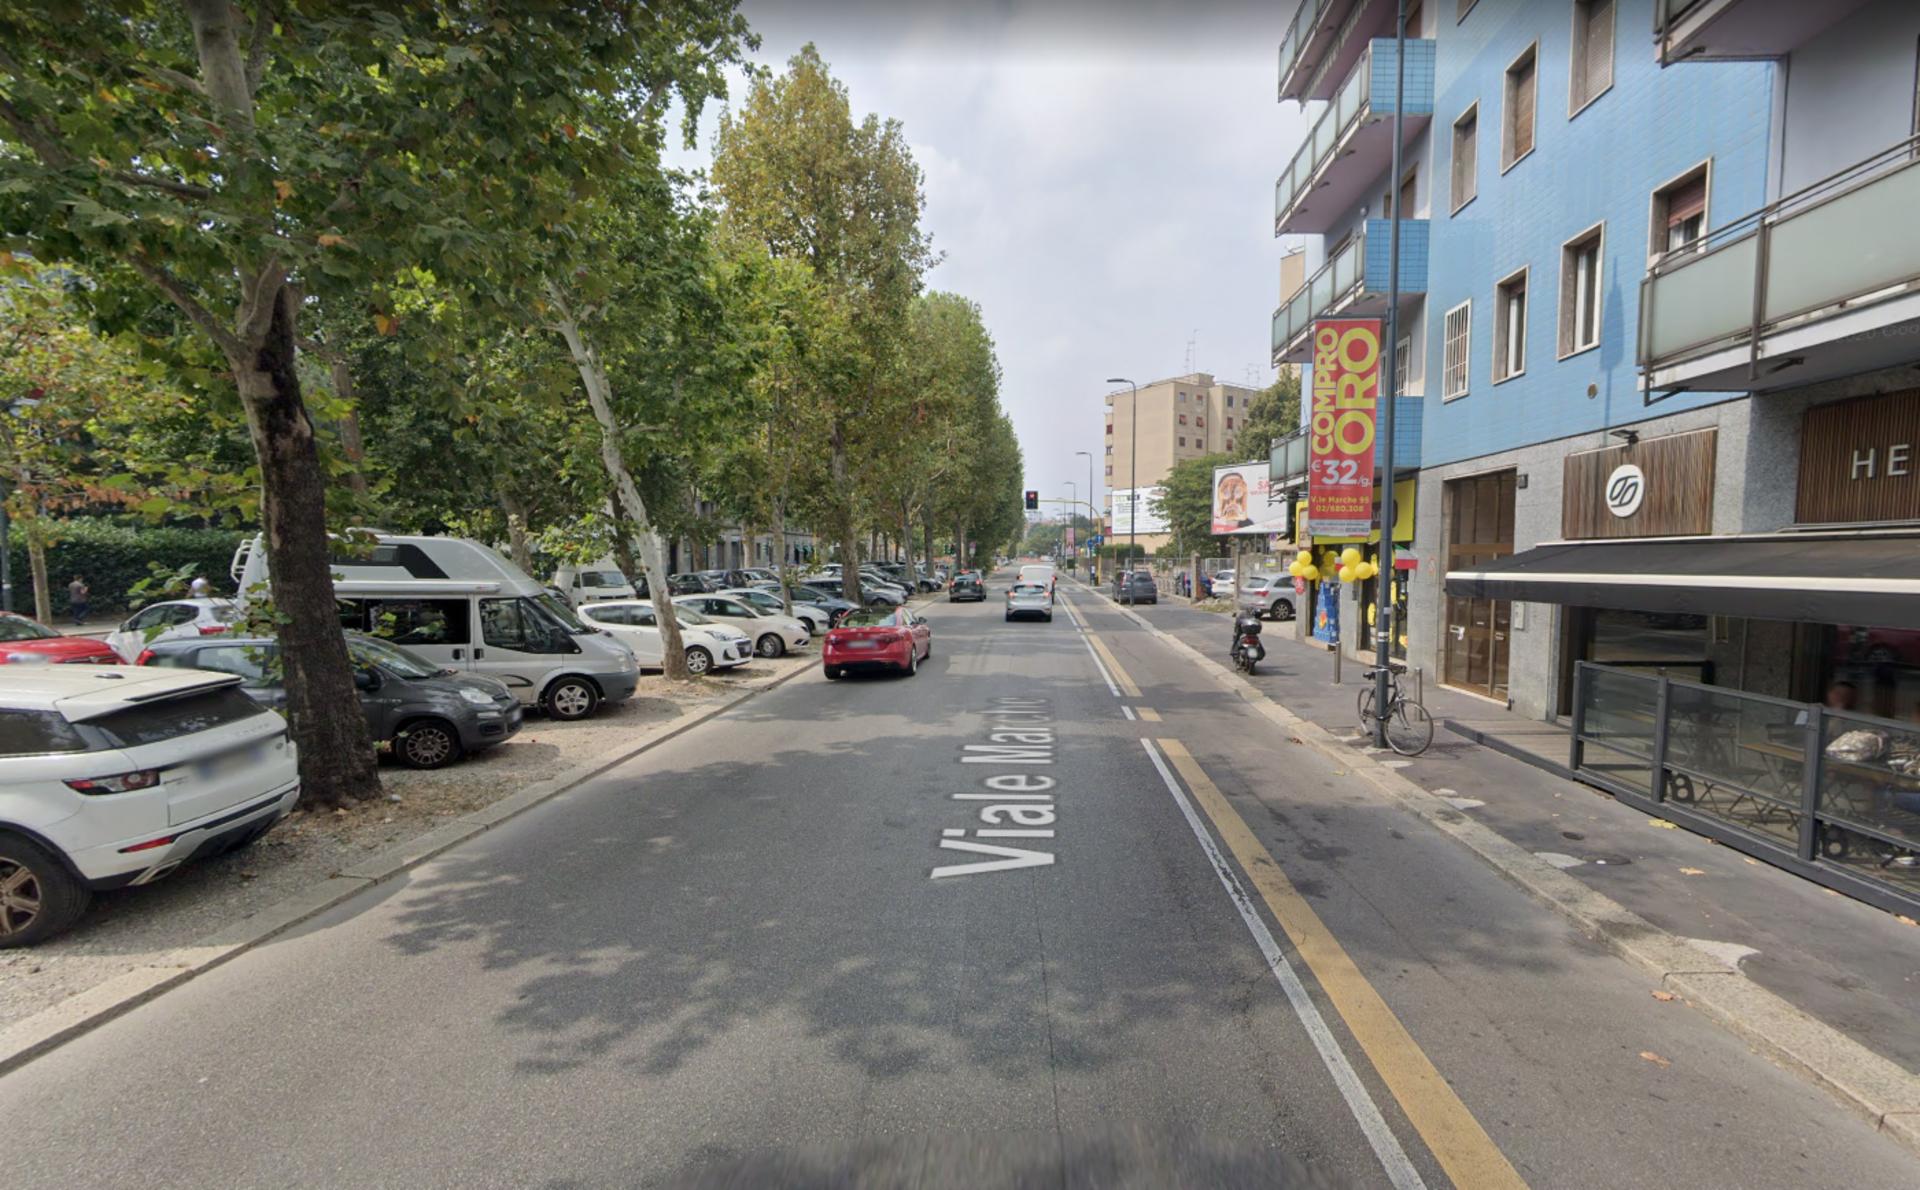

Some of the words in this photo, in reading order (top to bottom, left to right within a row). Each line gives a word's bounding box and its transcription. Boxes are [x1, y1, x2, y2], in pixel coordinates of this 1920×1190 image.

[1312, 327, 1339, 455] COMPRO
[1334, 327, 1379, 455] ORO
[1851, 444, 1910, 479] HE
